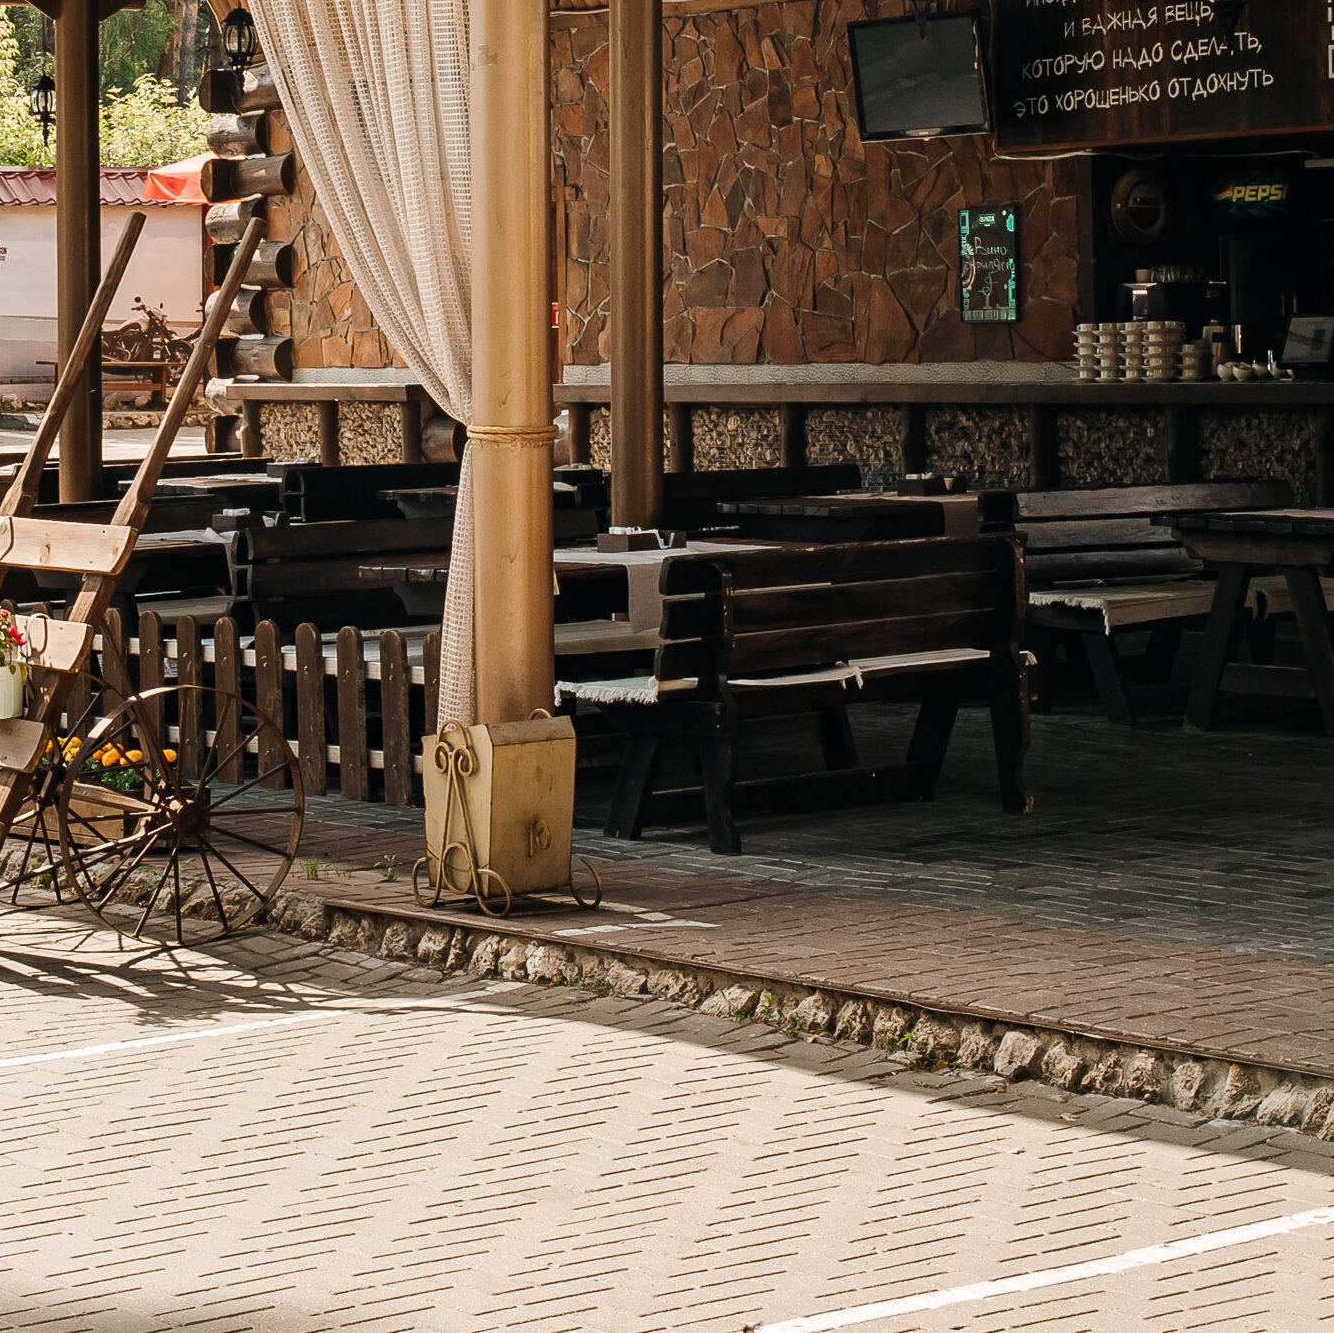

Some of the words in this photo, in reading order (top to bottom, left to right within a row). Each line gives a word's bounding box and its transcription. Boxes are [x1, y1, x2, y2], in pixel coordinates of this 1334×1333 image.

[1064, 21, 1075, 39] И
[1082, 7, 1157, 36] ВАЖНАЯ
[1022, 50, 1105, 80] КОТОРУЮ
[1113, 43, 1163, 70] НАДО
[1014, 95, 1049, 118] ЭТО
[1056, 81, 1160, 112] ХОРОШЕНЬКО
[1168, 68, 1274, 101] ОТДОХНУТЬ
[1232, 184, 1289, 202] PEPSI
[974, 236, 1007, 255] Вино
